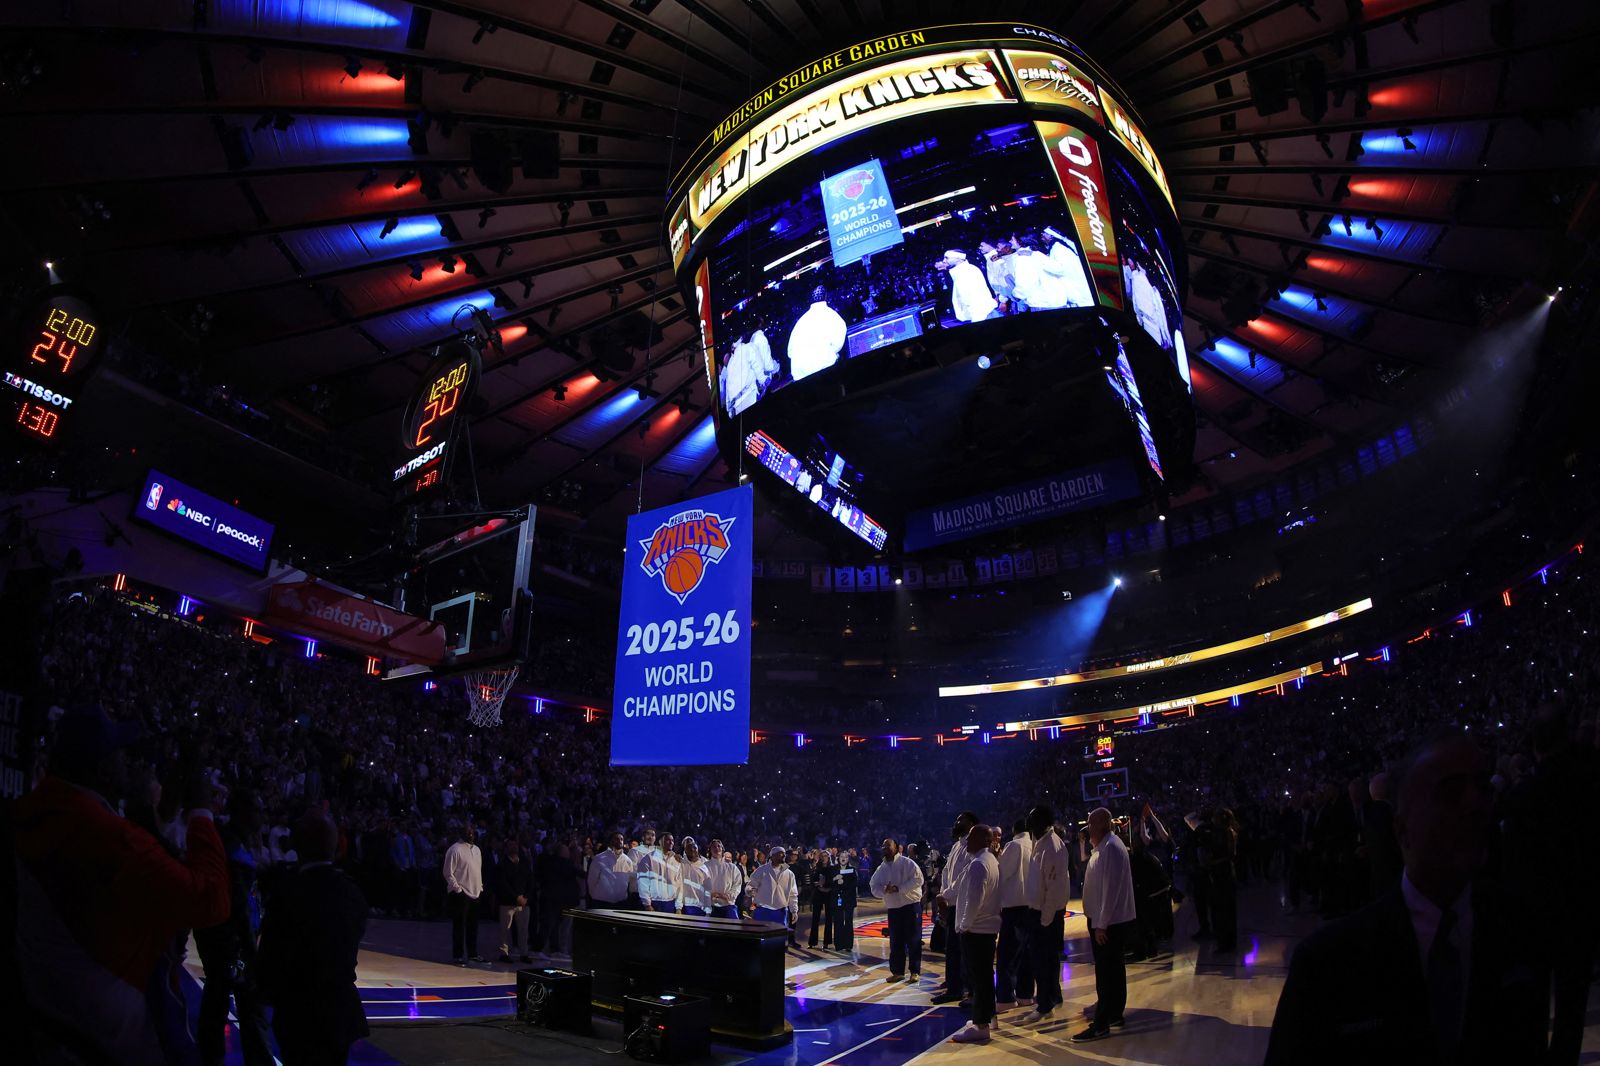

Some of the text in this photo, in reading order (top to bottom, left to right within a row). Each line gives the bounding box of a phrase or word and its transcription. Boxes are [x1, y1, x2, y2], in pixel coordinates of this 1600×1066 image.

[1013, 27, 1070, 48] CHASE
[712, 31, 925, 146] MADISON SQUARE GARDEN
[698, 61, 997, 218] NEW YORK KNICKS
[831, 195, 888, 226] 2025-26
[844, 213, 879, 232] WORLD
[1068, 168, 1107, 257] freedom
[836, 219, 893, 247] CHAMPIONS
[46, 308, 95, 346] 12:00
[32, 331, 77, 373] 24
[23, 378, 72, 410] TISSOT
[429, 363, 467, 403] 12:00
[18, 402, 58, 437] 1:30
[407, 441, 446, 472] TISSOT
[669, 511, 703, 526] NEW YORK
[932, 473, 1104, 532] MADISON SQUARE GARDEN
[185, 508, 260, 548] NBC peacock
[643, 514, 728, 567] KNICKS
[840, 572, 849, 585] 2
[863, 572, 871, 585] 3
[624, 609, 740, 657] 2025-26
[644, 660, 713, 688] WORLD
[623, 688, 736, 718] CHAMPIONS
[1097, 744, 1112, 756] 24
